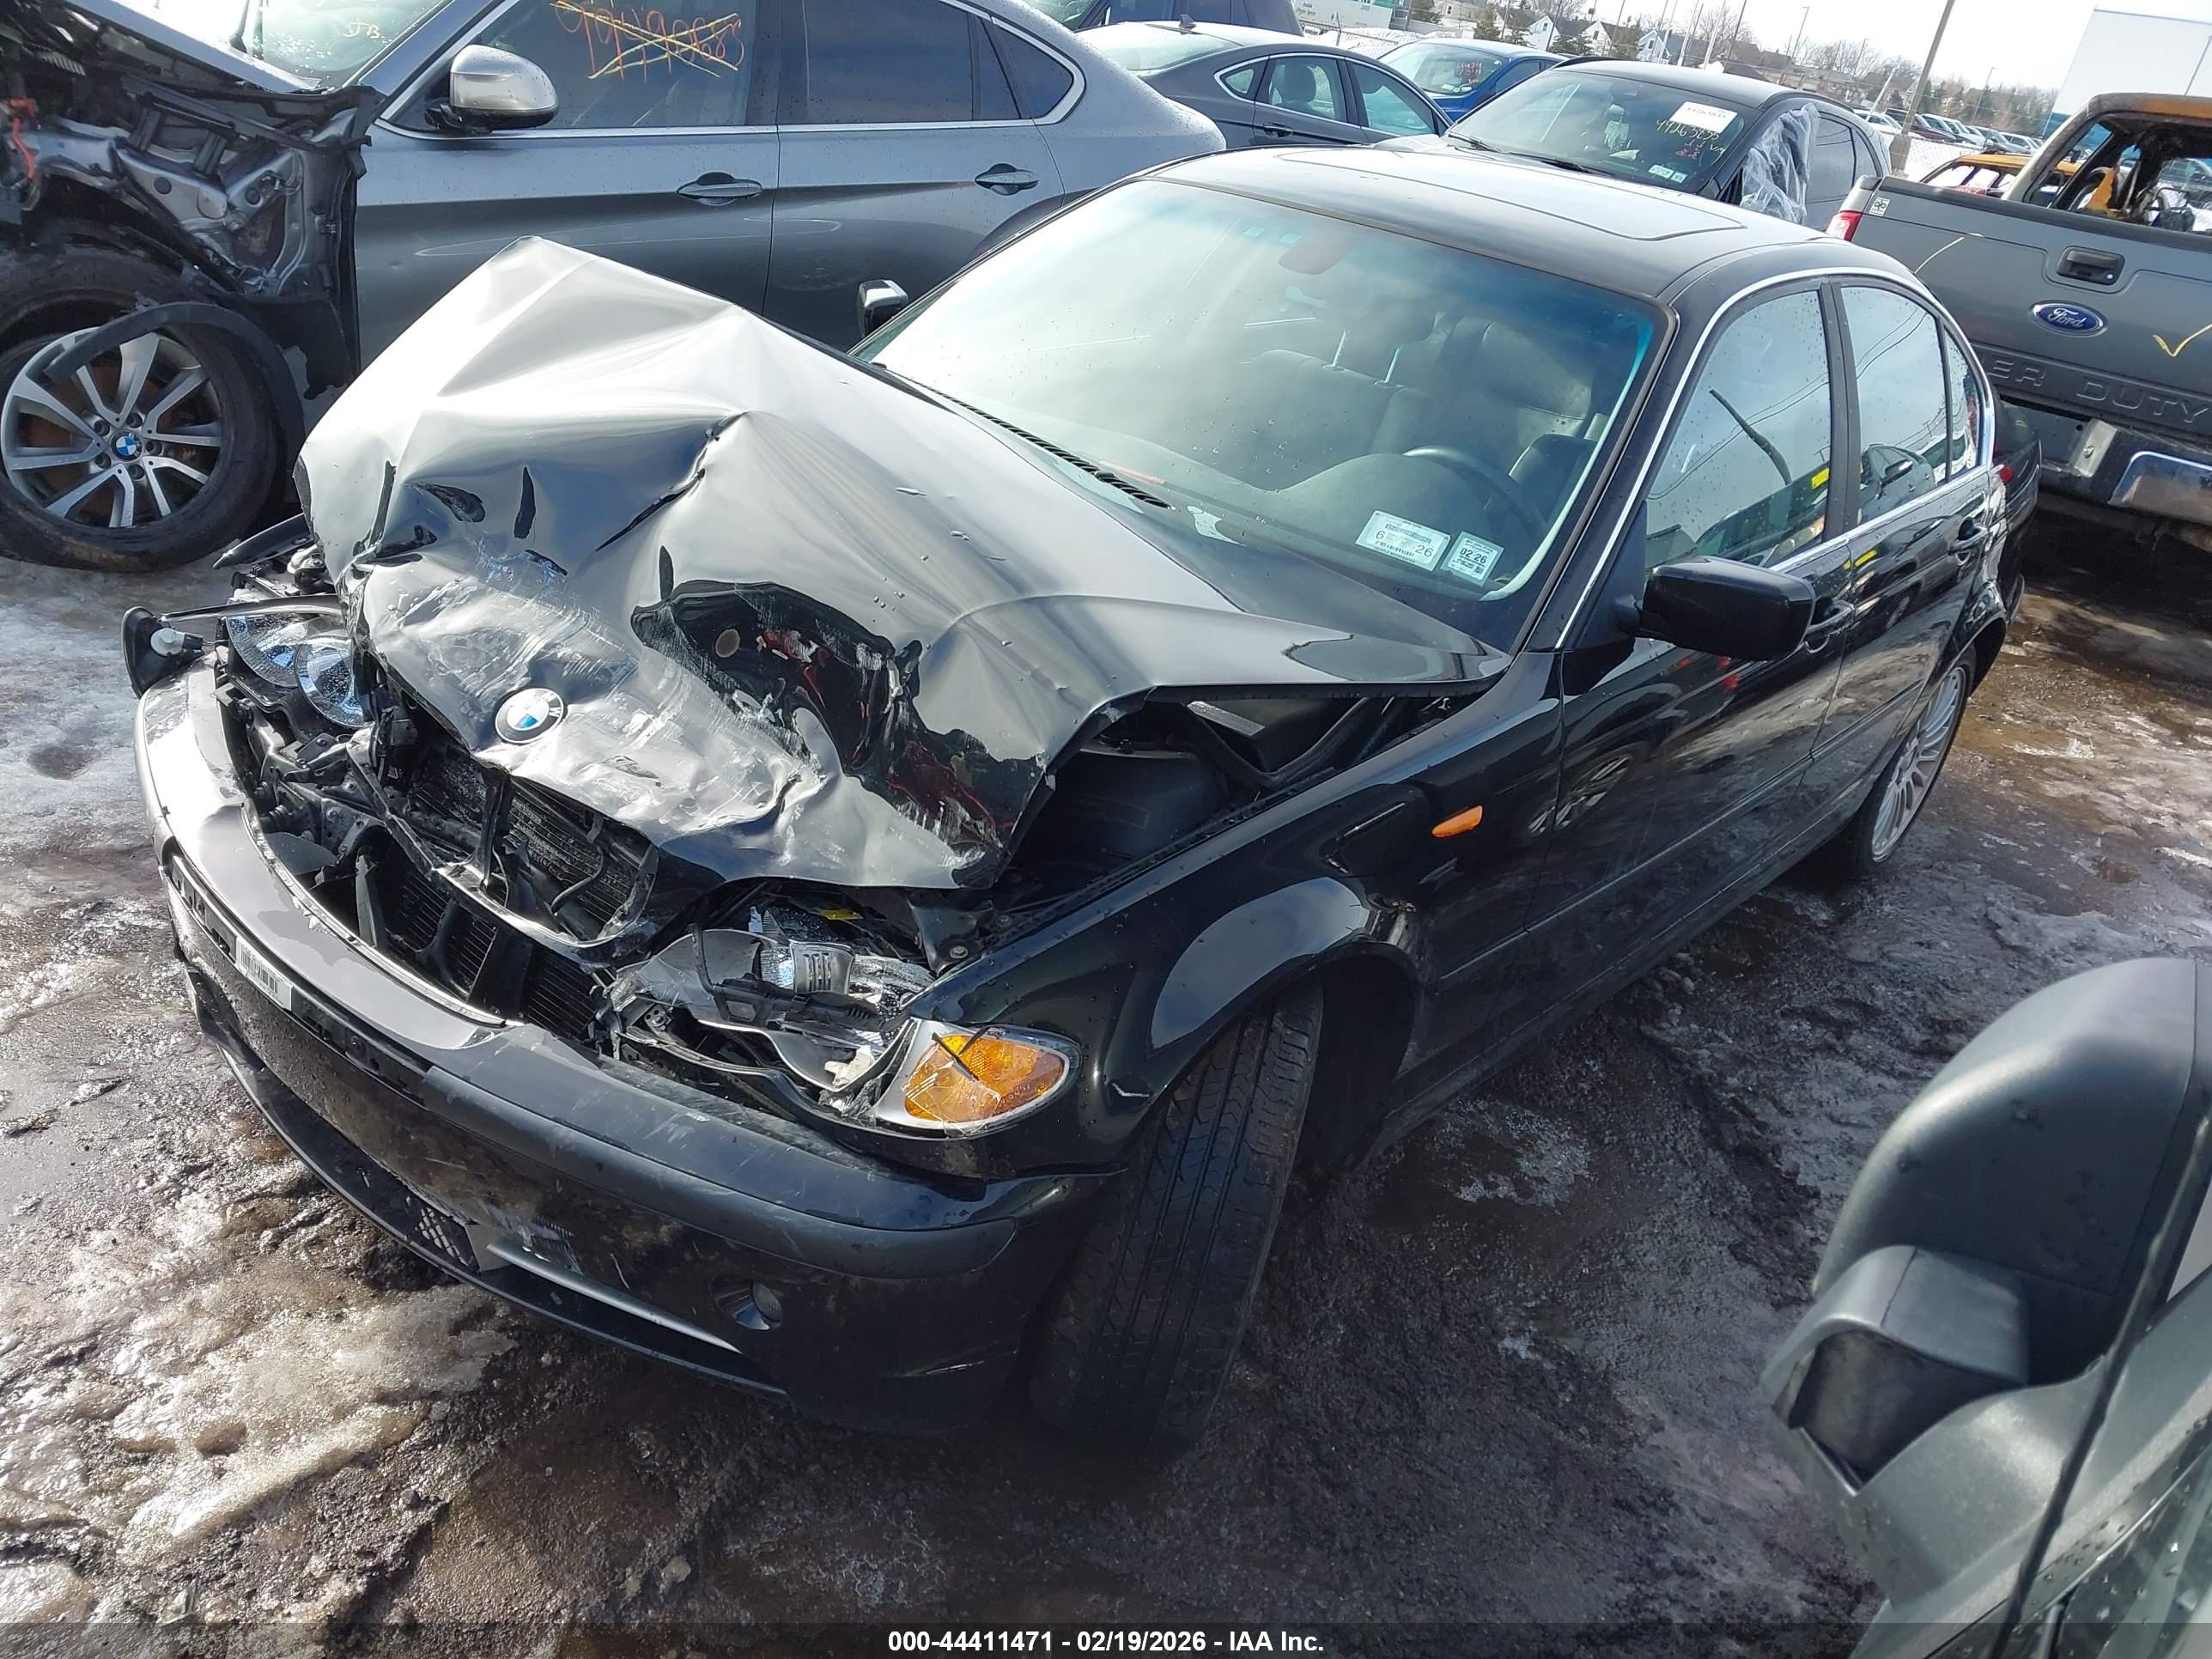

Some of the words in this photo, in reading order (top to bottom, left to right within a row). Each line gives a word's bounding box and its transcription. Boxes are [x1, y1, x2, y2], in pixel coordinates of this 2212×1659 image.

[2047, 307, 2086, 329] Ford
[2075, 380, 2209, 423] DUTY
[1376, 530, 1386, 541] 6
[1414, 544, 1433, 557] 26
[1460, 547, 1488, 564] 02-26
